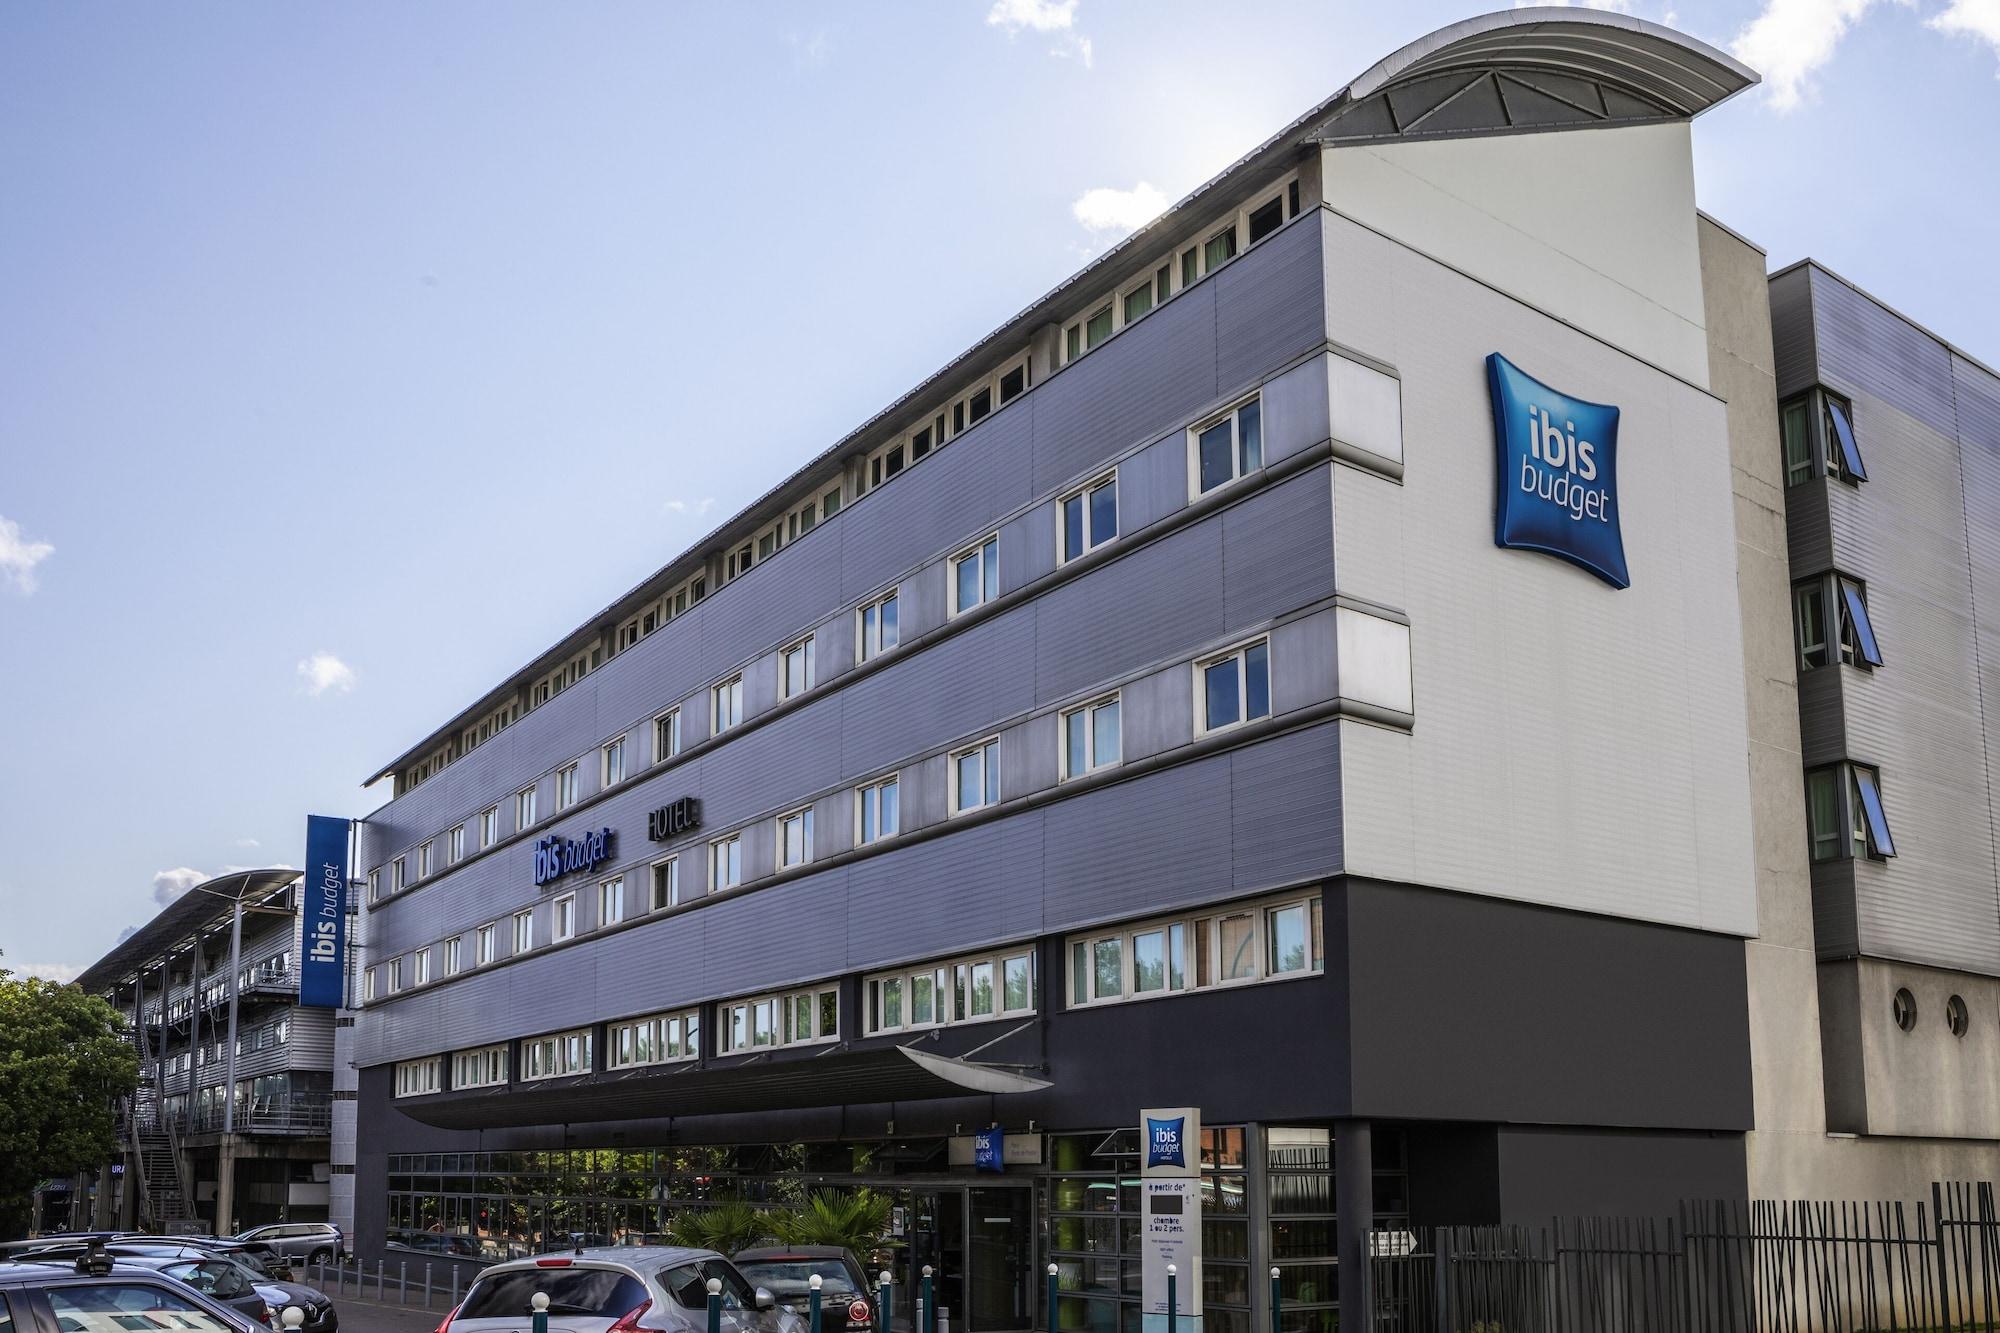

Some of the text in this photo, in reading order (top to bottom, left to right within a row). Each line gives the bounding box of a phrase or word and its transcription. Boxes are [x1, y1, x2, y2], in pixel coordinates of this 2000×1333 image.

[1529, 404, 1597, 481] ibis
[1521, 453, 1609, 523] budget
[563, 829, 607, 873] budget
[648, 797, 692, 841] HOTEL
[310, 862, 342, 963] ibis budget
[975, 1135, 990, 1149] ibis
[1156, 1127, 1177, 1143] ibis
[1152, 1142, 1180, 1155] budget
[1154, 1183, 1173, 1192] partir
[1153, 1216, 1180, 1225] chambre
